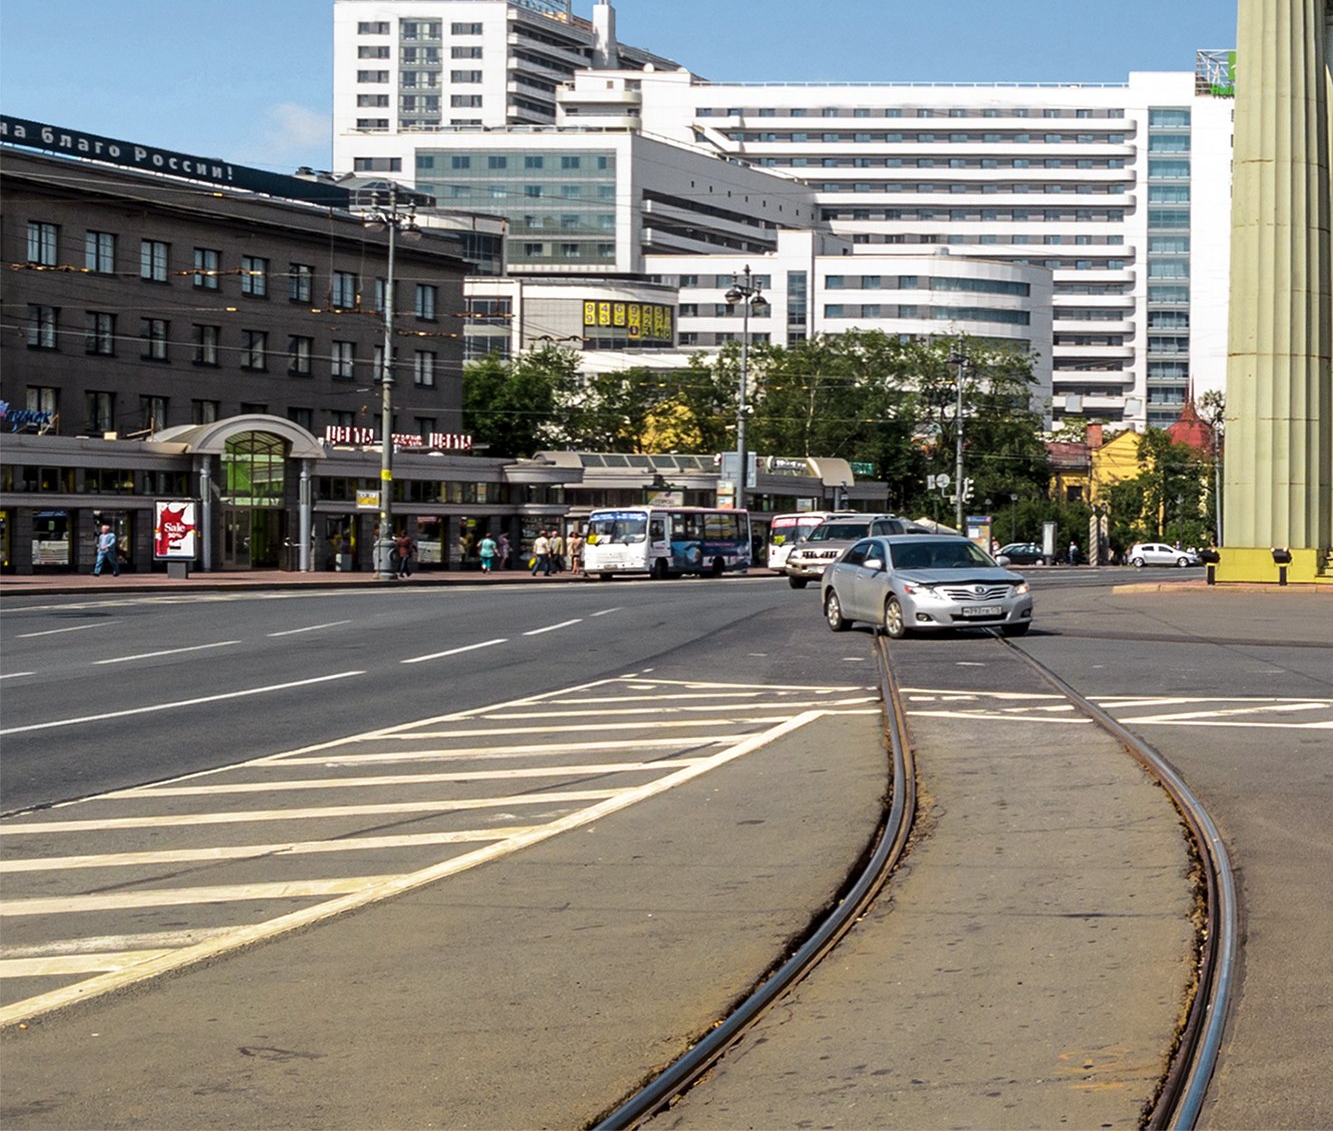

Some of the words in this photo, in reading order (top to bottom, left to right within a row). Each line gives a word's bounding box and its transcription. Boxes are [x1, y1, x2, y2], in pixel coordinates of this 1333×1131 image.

[41, 127, 121, 158] благо
[134, 146, 233, 181] России!
[164, 522, 186, 532] Sale
